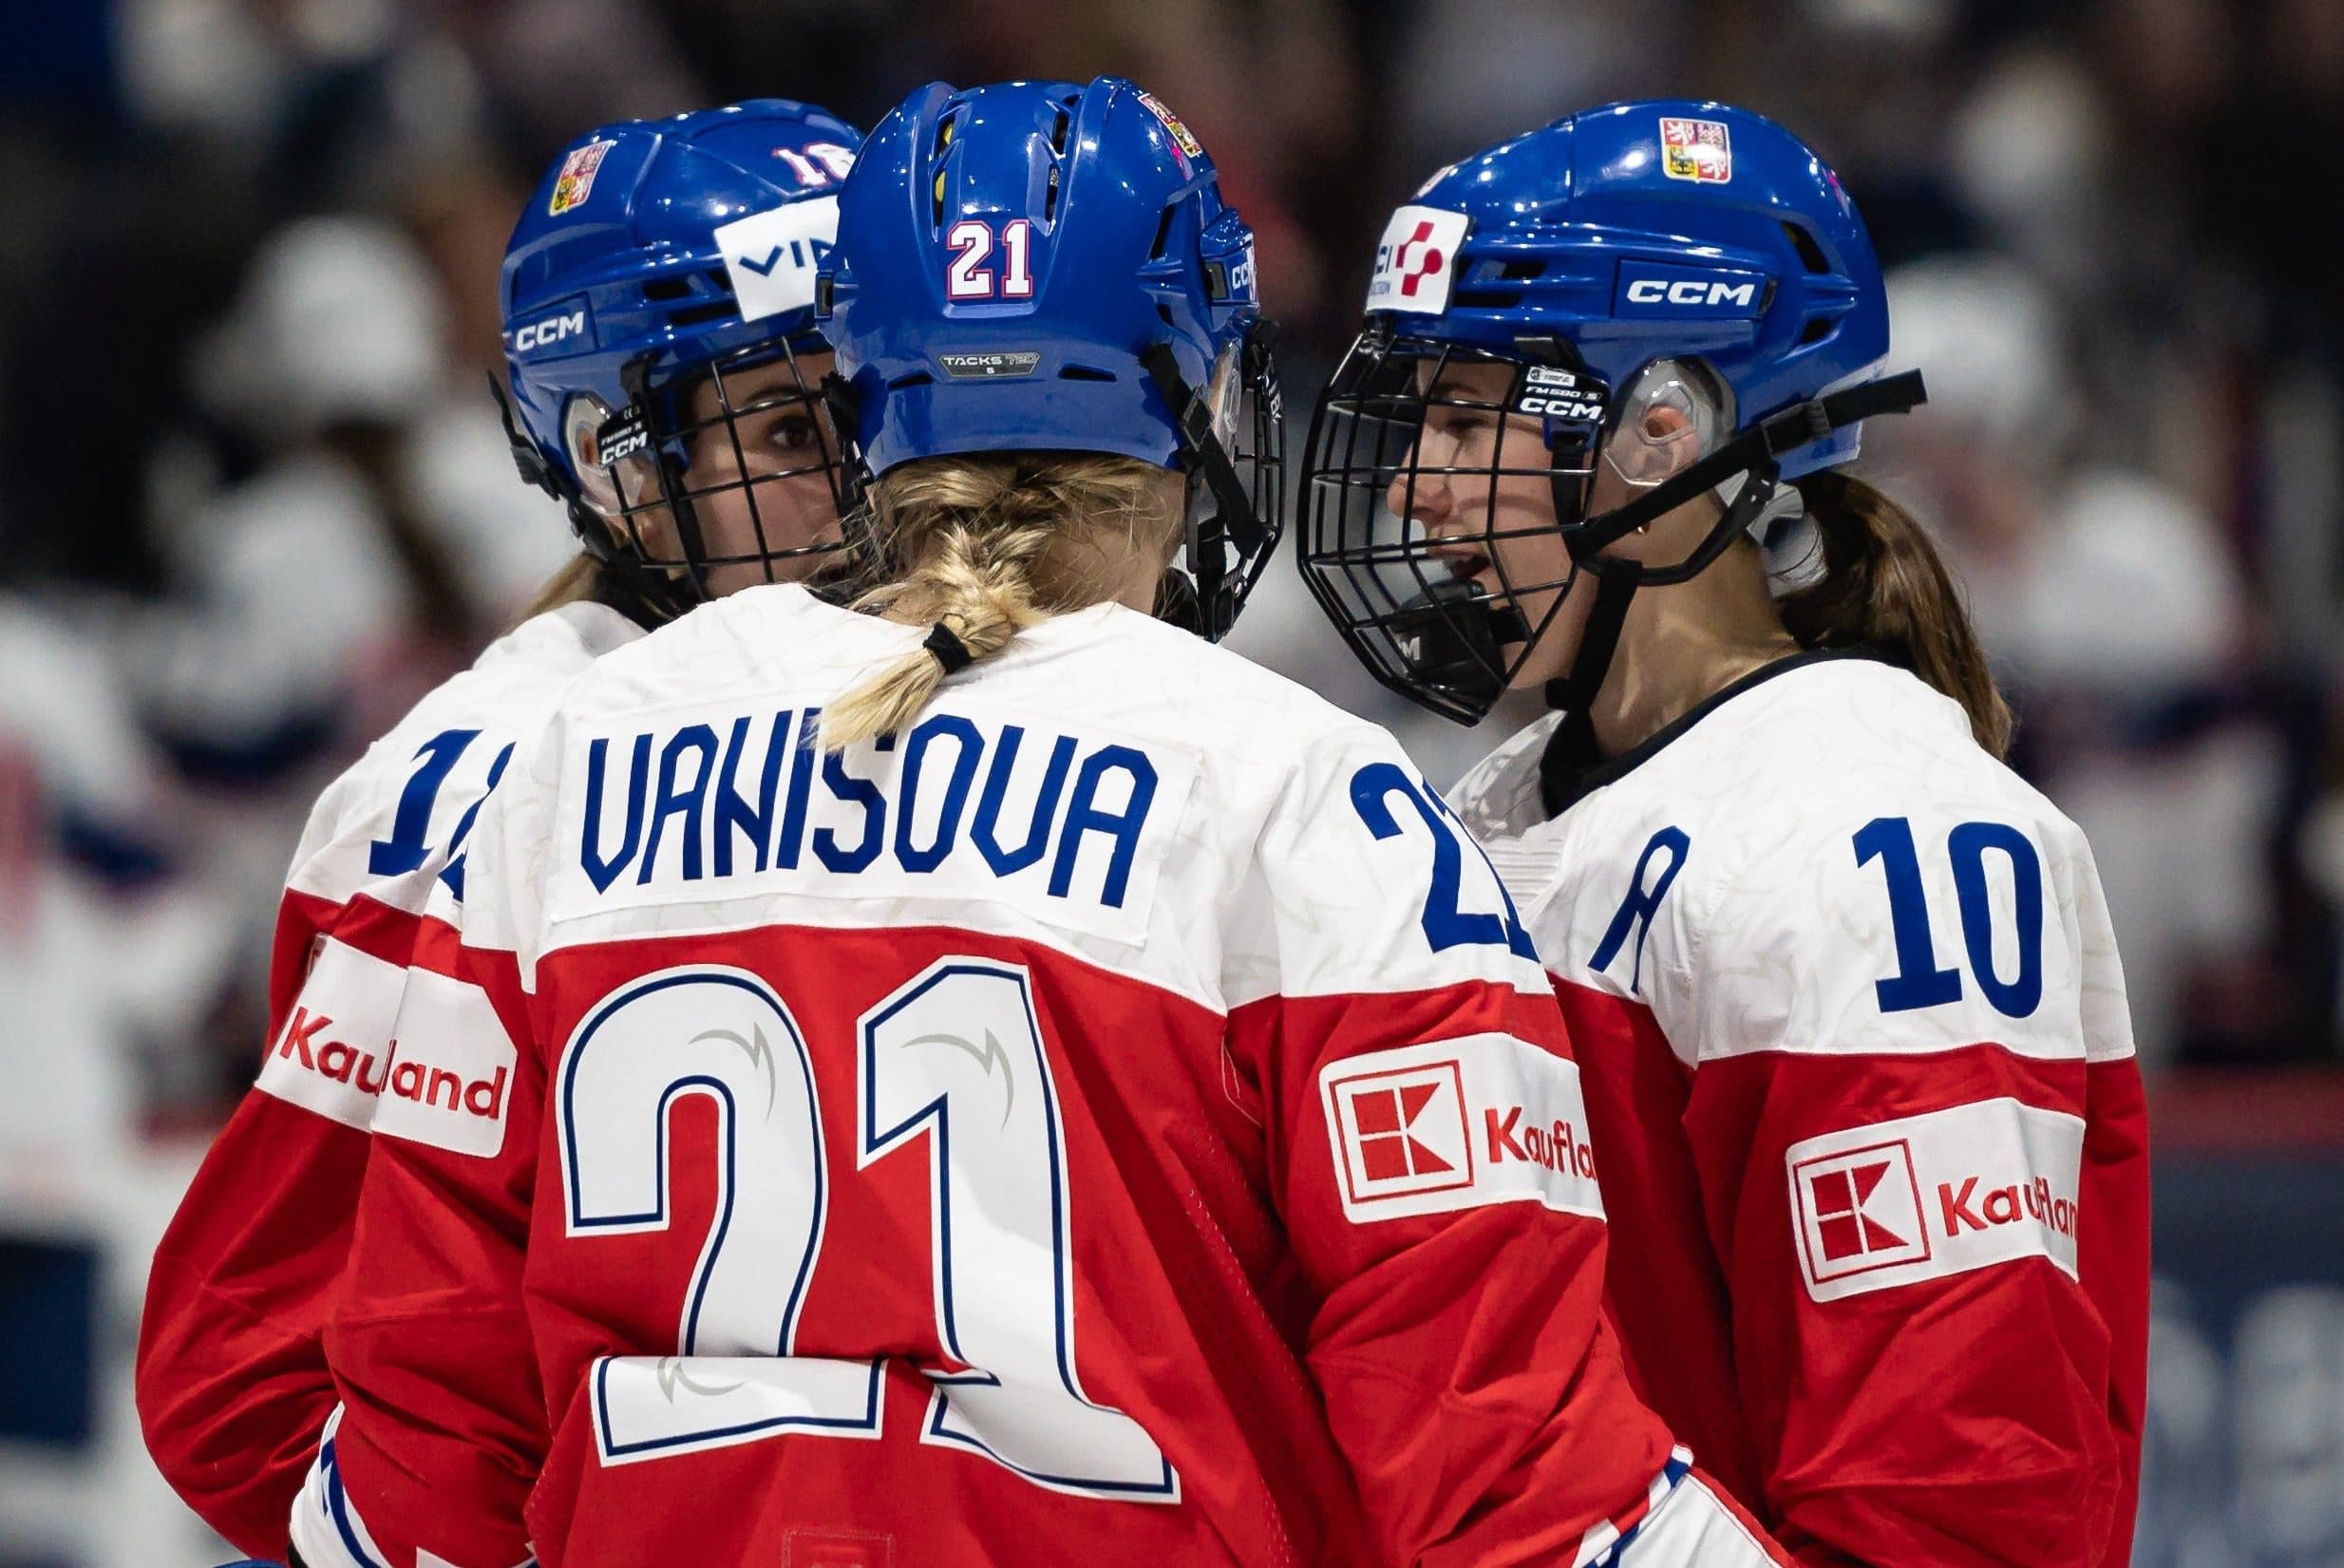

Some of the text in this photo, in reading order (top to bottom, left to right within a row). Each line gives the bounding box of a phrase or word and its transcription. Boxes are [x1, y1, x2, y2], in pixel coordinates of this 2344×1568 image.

[947, 219, 1032, 298] 21
[1627, 280, 1755, 306] CCM
[517, 312, 584, 351] CCM
[944, 356, 1003, 366] TACKS
[1520, 397, 1603, 420] CCM
[601, 431, 648, 464] CCM
[1587, 825, 1691, 995] A
[1852, 817, 2043, 1019] 10
[556, 954, 1181, 1504] 21
